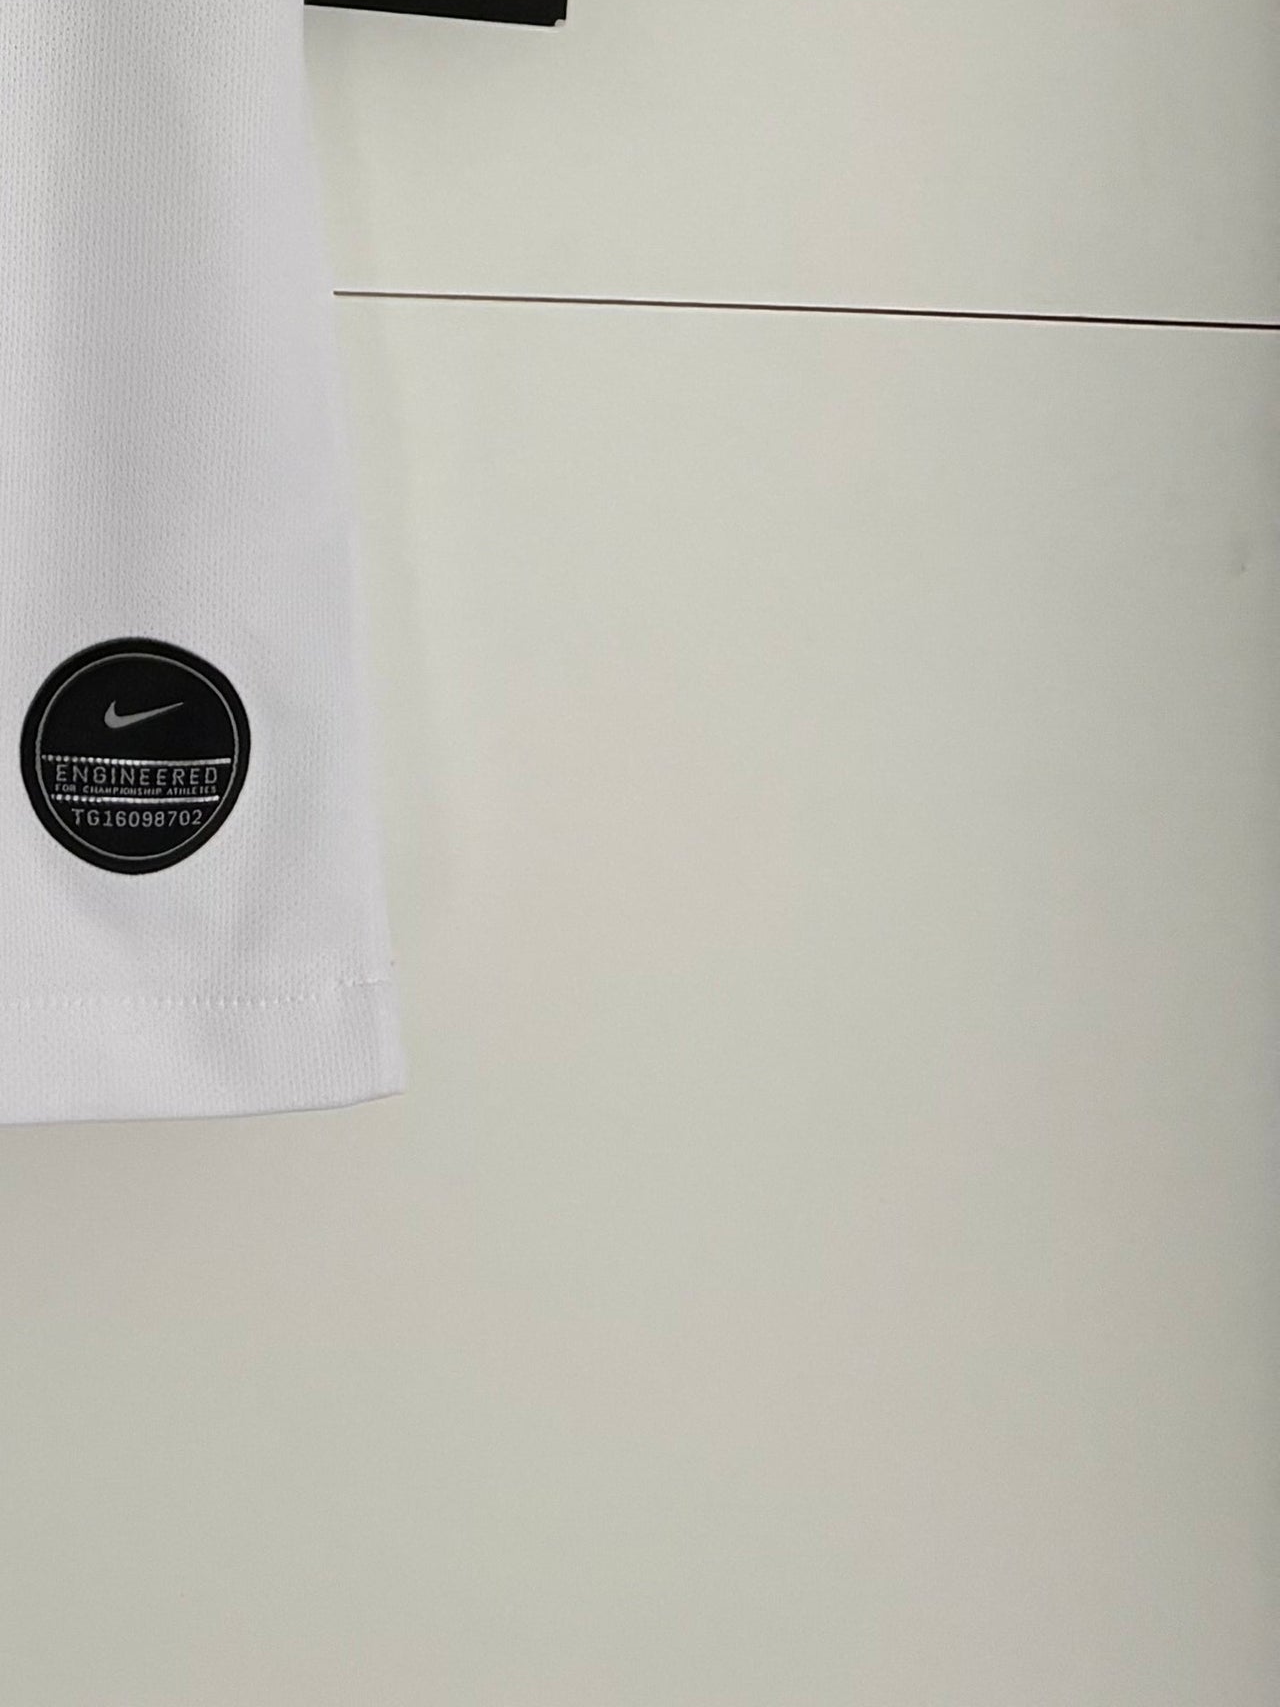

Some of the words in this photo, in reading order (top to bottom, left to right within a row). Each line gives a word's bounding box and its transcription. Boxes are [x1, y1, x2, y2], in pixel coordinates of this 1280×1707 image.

[56, 764, 218, 786] ENGINEERED
[55, 784, 77, 793] FOR
[83, 785, 162, 796] CHAMPIONSHIP
[166, 786, 217, 795] ATHLETES
[72, 808, 203, 828] TG16098702
